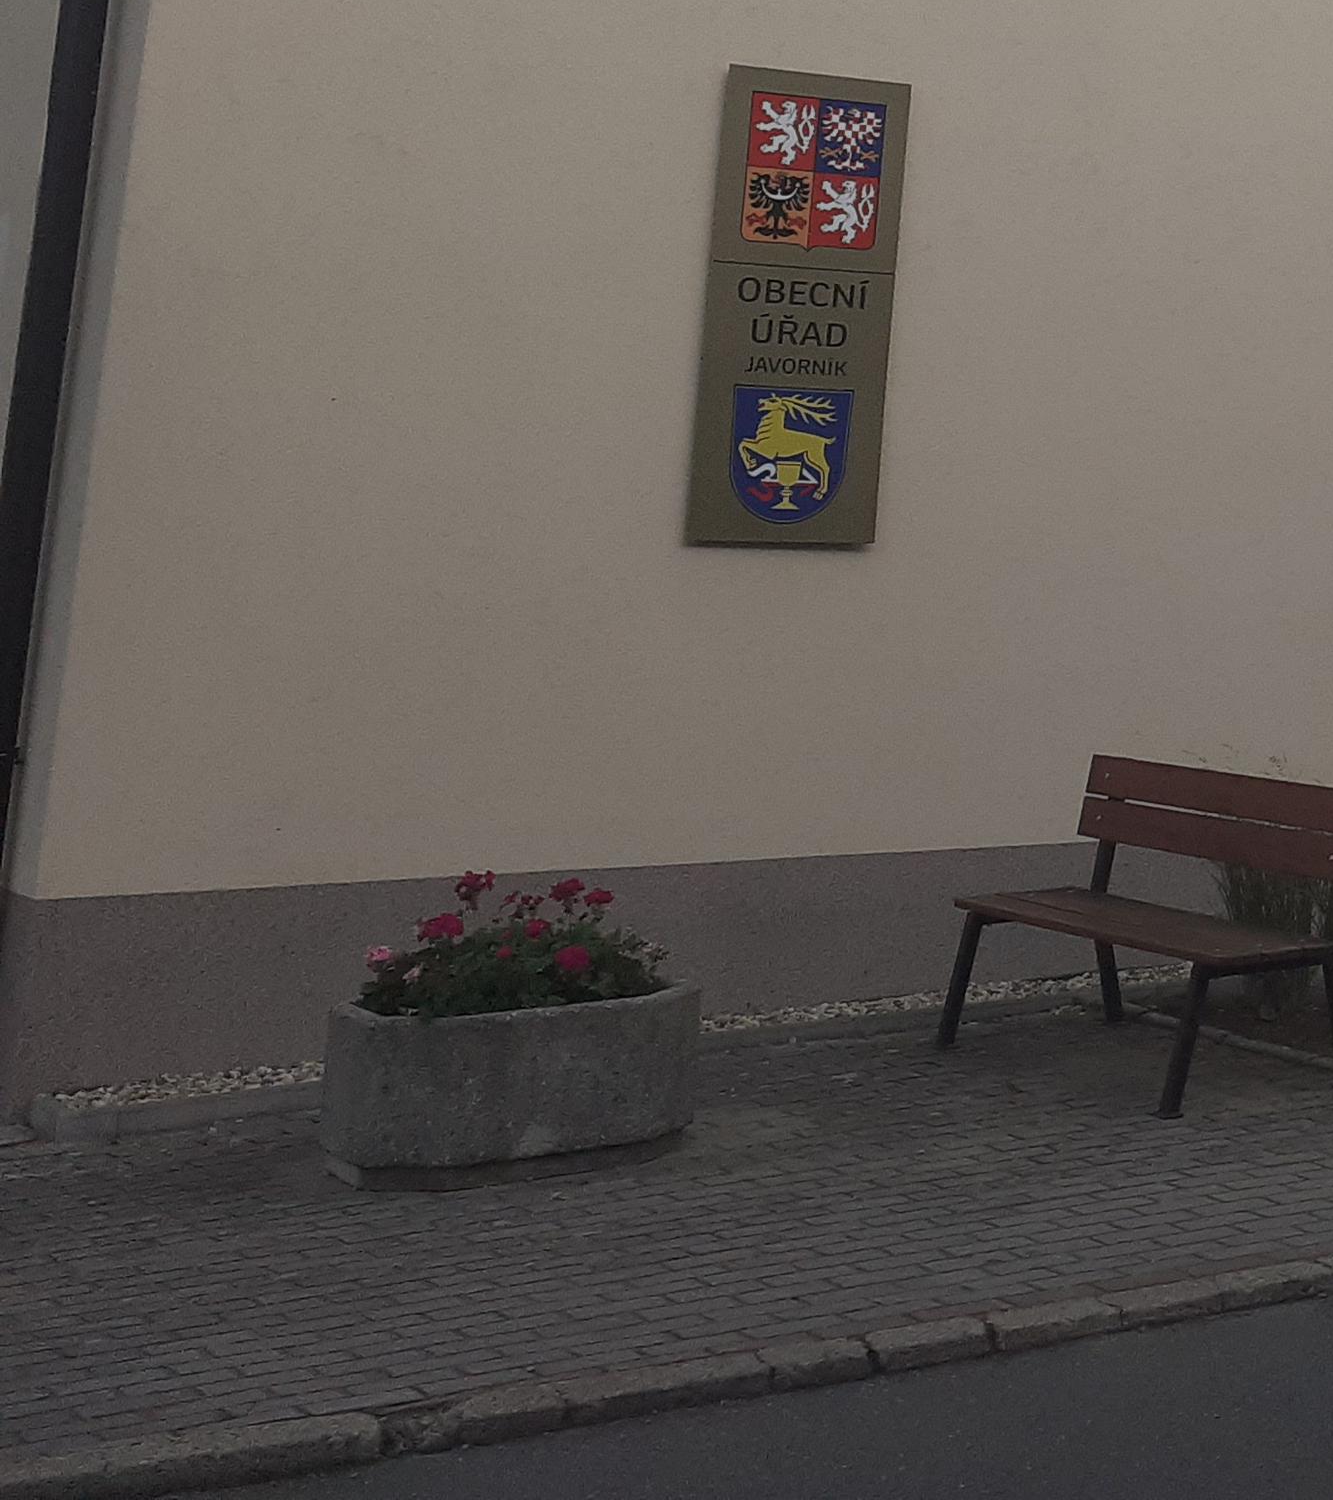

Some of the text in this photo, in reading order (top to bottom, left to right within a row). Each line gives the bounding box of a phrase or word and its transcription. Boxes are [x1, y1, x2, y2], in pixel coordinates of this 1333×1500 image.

[738, 276, 870, 310] OBECNÍ
[751, 313, 848, 348] ÚŘAD
[744, 356, 848, 377] JAVORNÍK
